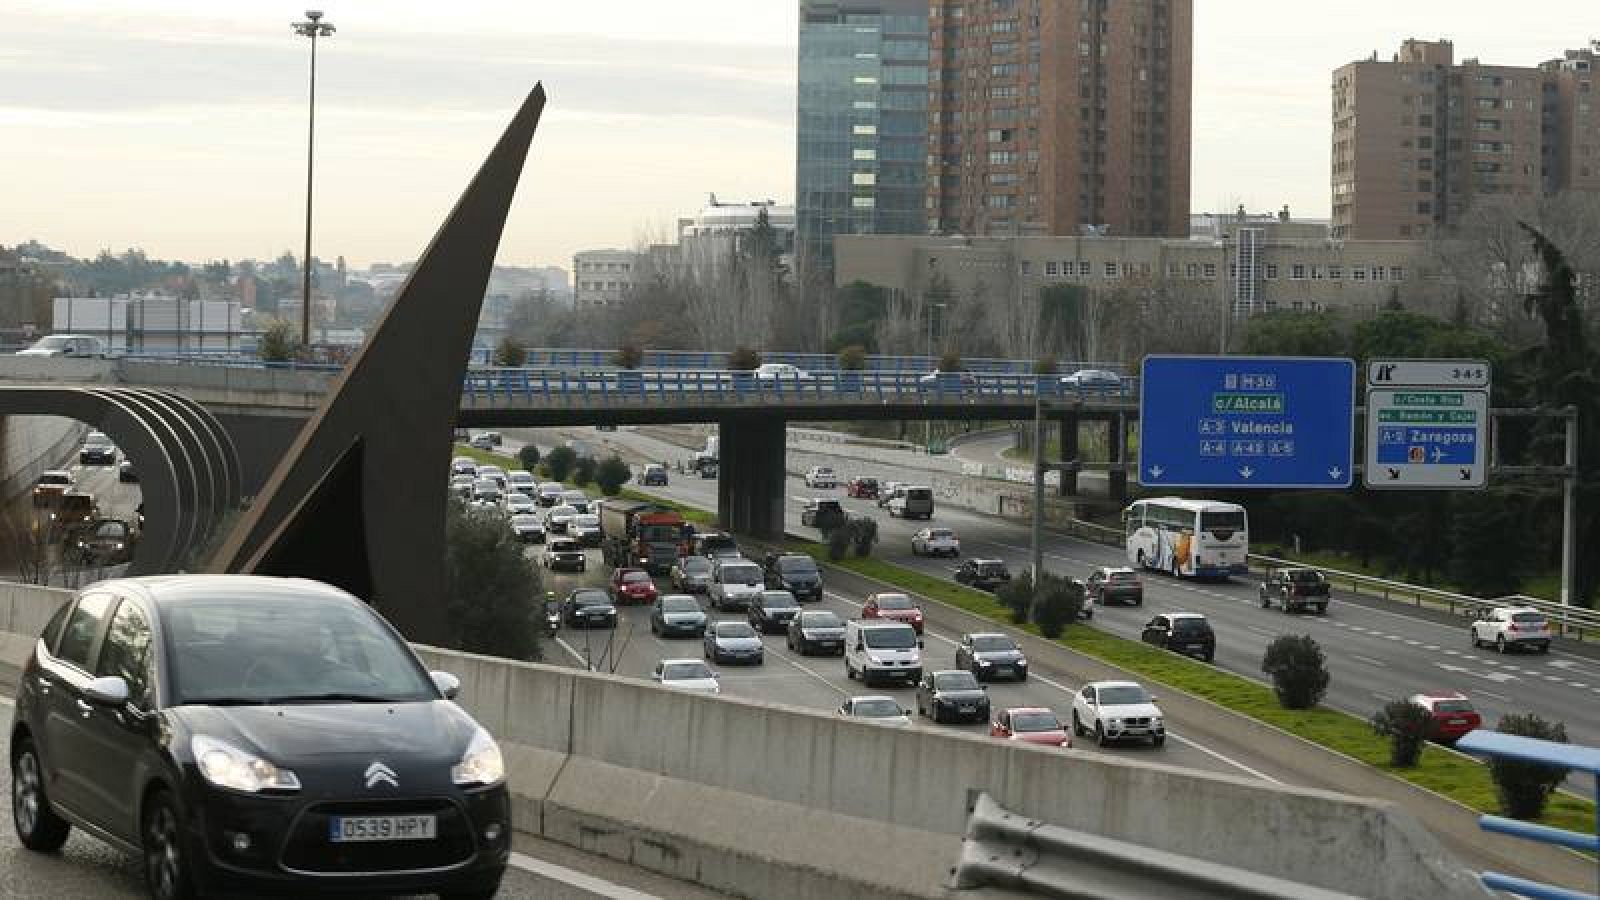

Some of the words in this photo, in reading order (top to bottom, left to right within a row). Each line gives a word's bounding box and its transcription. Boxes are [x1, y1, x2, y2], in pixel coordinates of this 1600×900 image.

[1215, 396, 1281, 409] c/Alcalá
[1231, 420, 1293, 433] Valencia
[1411, 429, 1474, 444] Zaragoza
